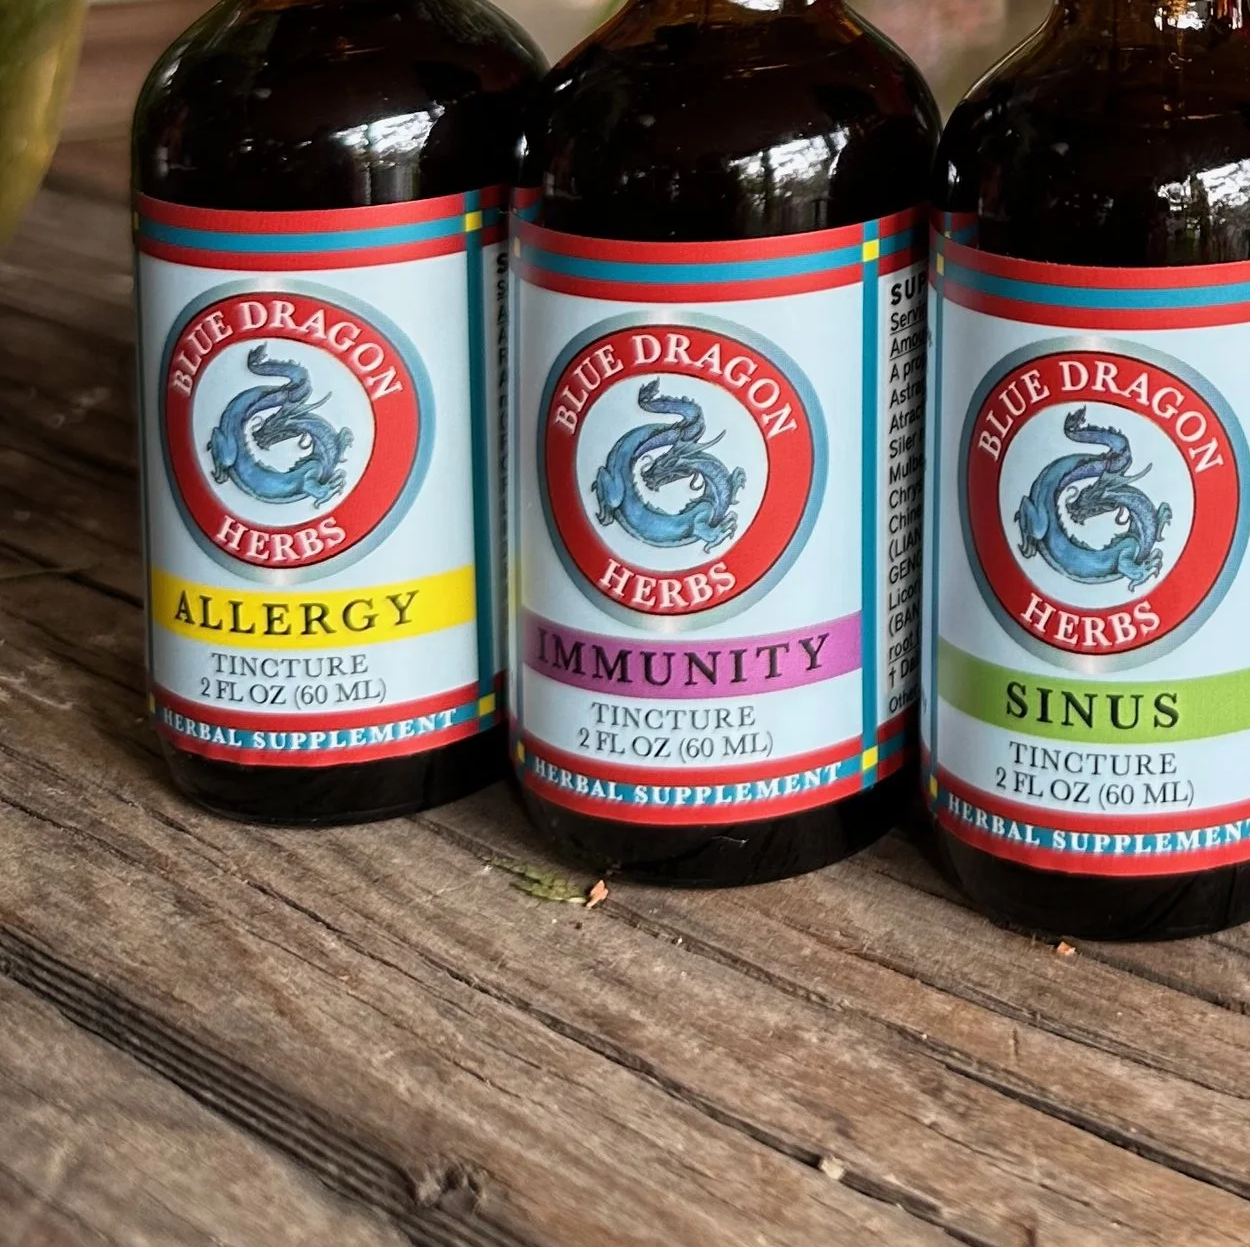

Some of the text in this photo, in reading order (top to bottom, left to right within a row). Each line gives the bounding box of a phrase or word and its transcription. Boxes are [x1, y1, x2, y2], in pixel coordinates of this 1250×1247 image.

[170, 299, 403, 402] BLUE DRAGON
[553, 332, 799, 440] BLUE DRAGON
[978, 359, 1225, 475] BLUE DRAGON
[215, 516, 347, 562] HERBS
[599, 559, 738, 610] HERBS
[173, 588, 421, 637] ALLERGY
[1021, 592, 1162, 648] HERBS
[211, 651, 370, 679] TINCTURE
[535, 628, 832, 686] IMMUNITY
[200, 677, 387, 710] 2 FL OZ (60 ML)
[590, 700, 757, 731] TINCTURE
[1005, 680, 1181, 731] SINUS
[162, 705, 459, 752] HERBAL SUPPLEMENT
[578, 728, 774, 763] 2 FL OZ (60 ML)
[532, 755, 843, 806] HERBAL SUPPLEMENT
[1008, 739, 1179, 776] TINCTURE
[994, 766, 1196, 810] 2 FL OZ (60 ML)
[946, 791, 1041, 847] HERBAL
